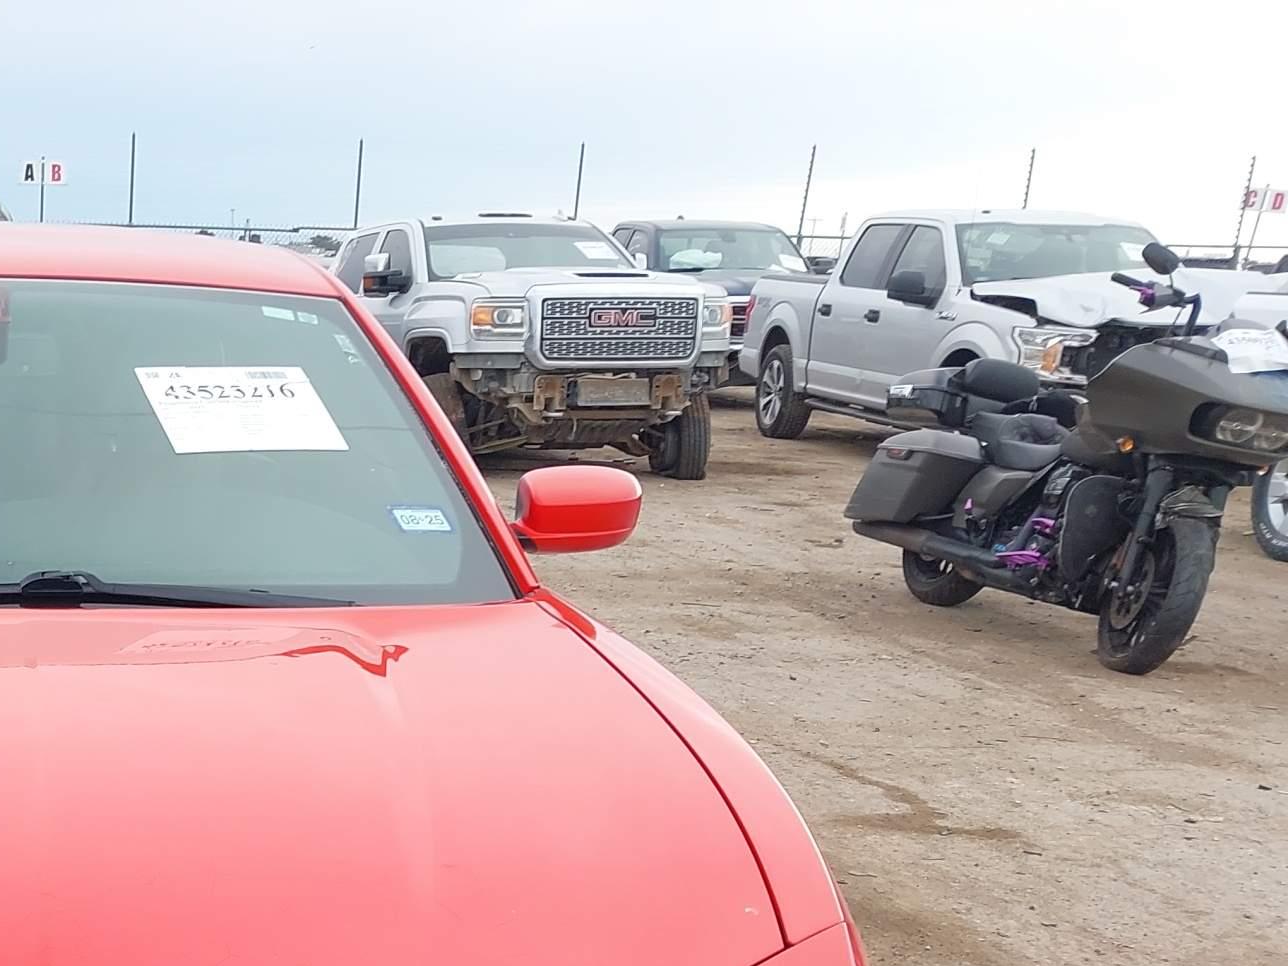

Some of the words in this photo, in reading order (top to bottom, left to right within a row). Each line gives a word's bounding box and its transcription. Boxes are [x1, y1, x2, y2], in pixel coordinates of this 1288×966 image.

[24, 163, 34, 181] A
[52, 164, 61, 181] B
[1272, 192, 1284, 210] D
[592, 309, 655, 326] GMC
